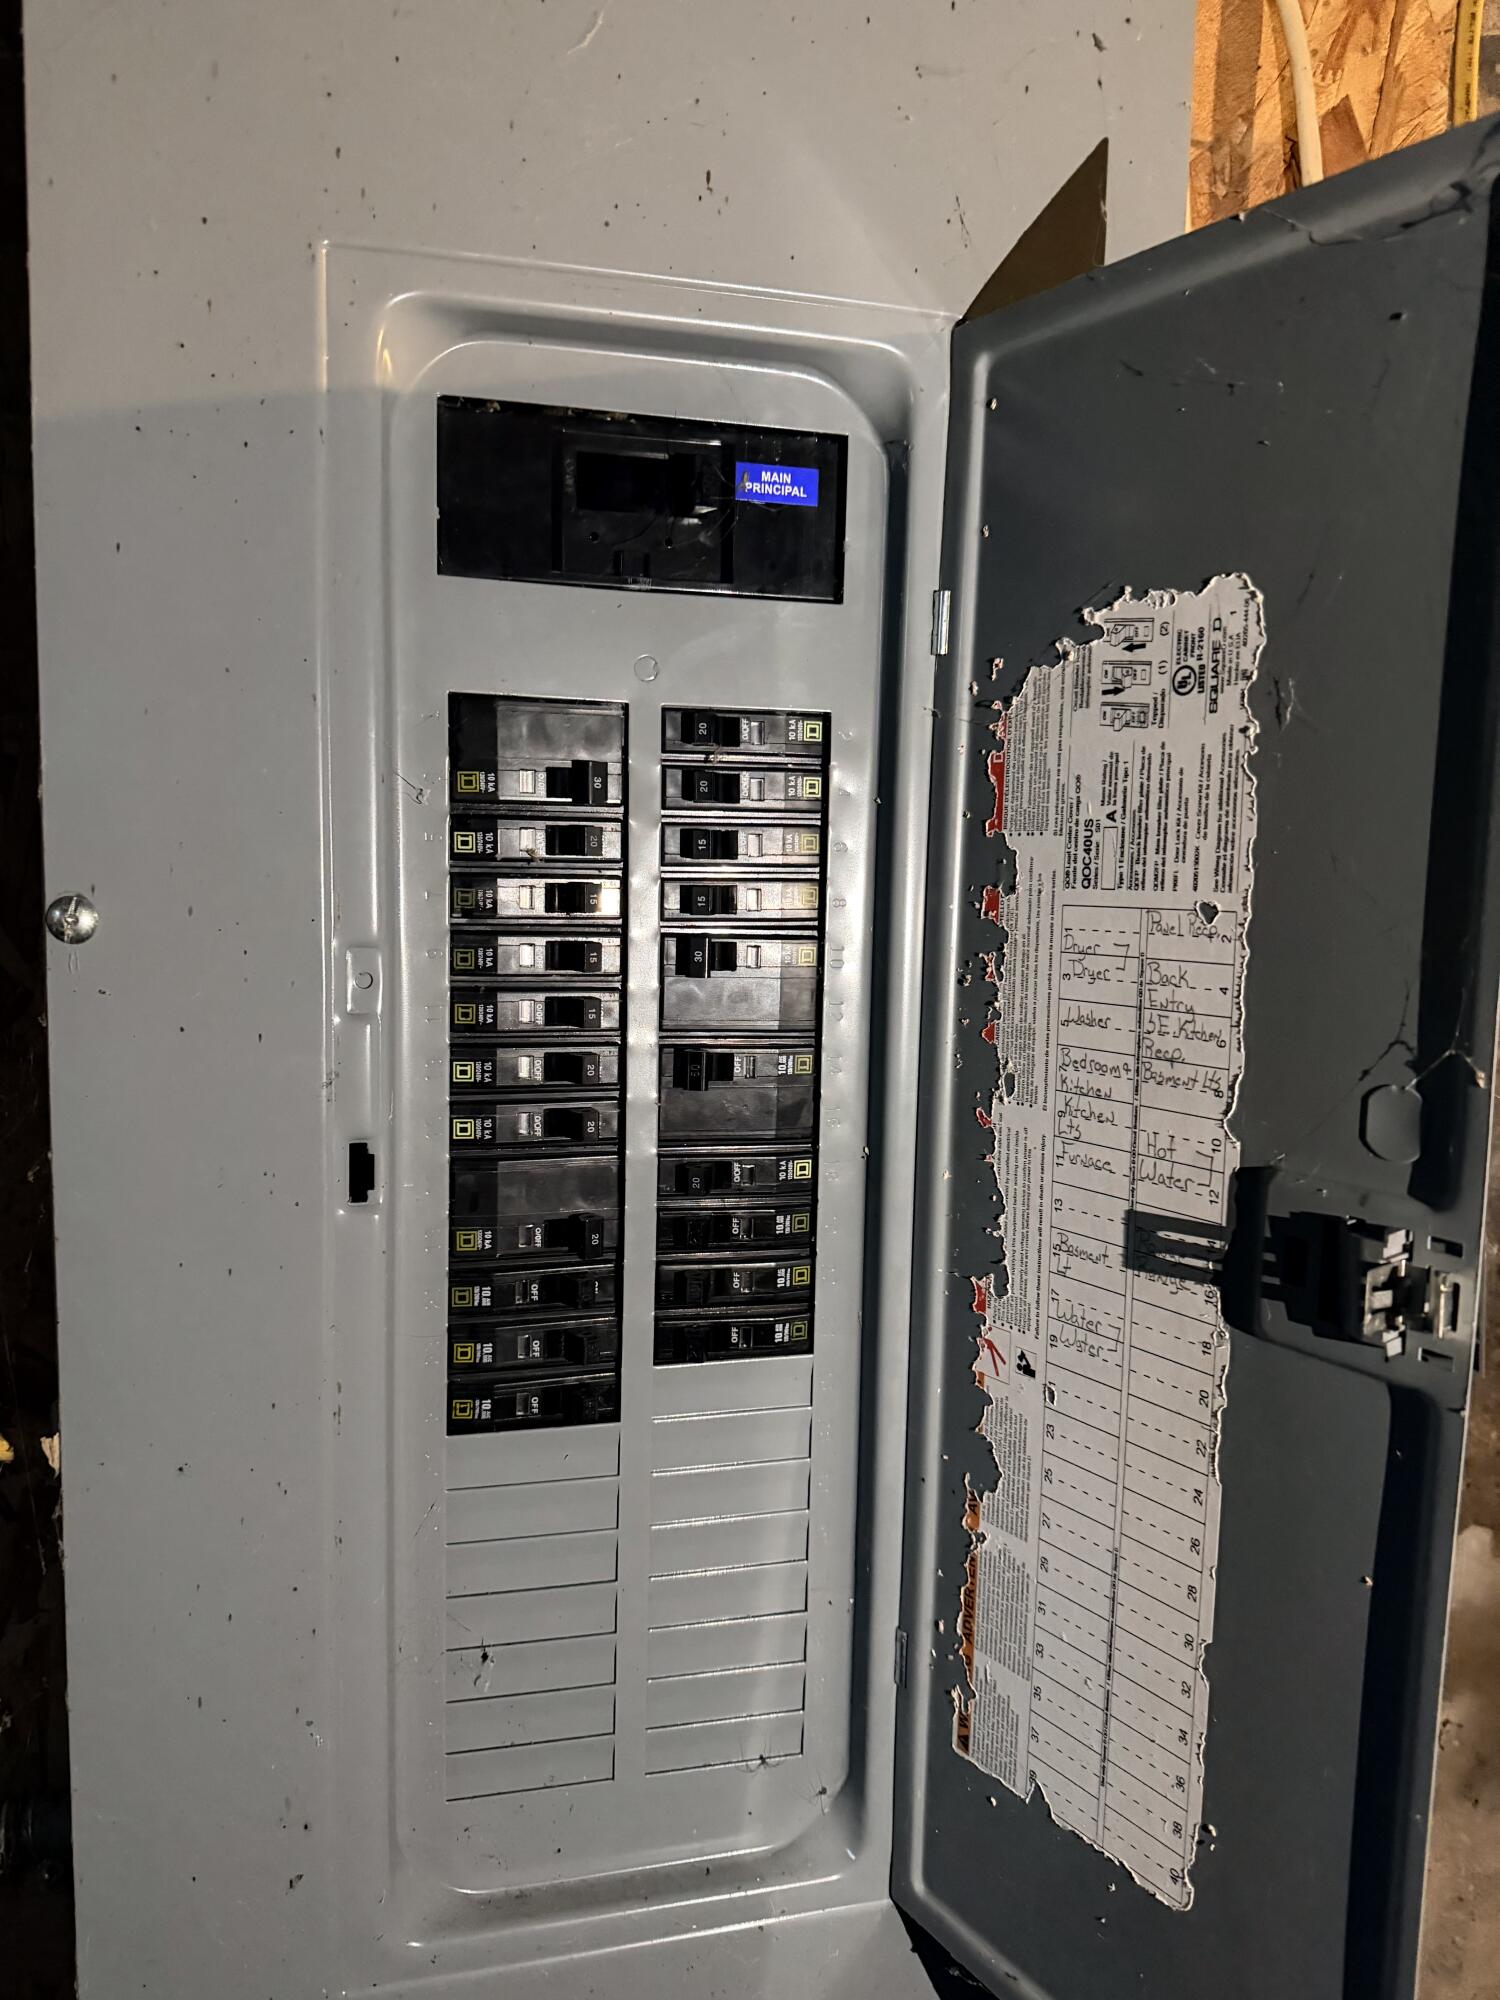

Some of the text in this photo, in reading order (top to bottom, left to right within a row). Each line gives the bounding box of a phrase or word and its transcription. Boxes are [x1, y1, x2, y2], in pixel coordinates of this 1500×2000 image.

[762, 471, 791, 484] MAIN
[745, 482, 807, 498] PRINCIPAL
[1160, 622, 1169, 636] (2)
[1196, 626, 1204, 661] R-2160
[1158, 660, 1168, 675] (1)
[1208, 617, 1222, 714] SQUARE D
[1197, 664, 1206, 694] LISTED
[1151, 696, 1159, 726] Tripped
[1158, 688, 1166, 728] Disparado
[698, 722, 707, 735] 20
[1122, 766, 1130, 782] Tipo
[594, 777, 602, 788] 30
[700, 780, 708, 792] 20
[1106, 810, 1117, 822] A
[590, 836, 598, 847] 20
[698, 839, 706, 850] 15
[1082, 818, 1094, 890] QOC40US
[590, 894, 598, 905] 15
[698, 896, 706, 908] 15
[1220, 934, 1232, 943] 2
[1064, 934, 1101, 962] Dryer
[590, 952, 598, 964] 15
[694, 951, 702, 962] 30
[1068, 960, 1110, 984] Dryer
[1147, 962, 1189, 988] Back
[1219, 987, 1228, 996] 4
[588, 1008, 596, 1019] 15
[1216, 1040, 1226, 1048] 6
[587, 1064, 595, 1076] 20
[734, 1056, 742, 1074] OFF
[1060, 1048, 1121, 1076] Bedroom
[1214, 1090, 1224, 1098] 8
[1058, 1110, 1066, 1118] 9
[587, 1121, 595, 1133] 20
[1147, 1132, 1176, 1160] Hot
[1211, 1138, 1222, 1154] 10
[1056, 1154, 1064, 1167] 11
[692, 1177, 700, 1189] 20
[1140, 1158, 1196, 1192] Water
[1208, 1189, 1219, 1204] 12
[1054, 1198, 1062, 1212] 13
[732, 1218, 740, 1234] OFF
[592, 1234, 600, 1246] 20
[1052, 1244, 1060, 1257] 15
[531, 1284, 539, 1301] OFF
[1051, 1288, 1060, 1302] 17
[1204, 1289, 1214, 1306] 16
[1056, 1300, 1102, 1333] Water
[532, 1340, 540, 1358] OFF
[1050, 1334, 1058, 1348] 19
[1060, 1324, 1104, 1358] Water
[1202, 1340, 1212, 1356] 18
[531, 1396, 539, 1414] OFF
[1199, 1390, 1209, 1408] 20
[1046, 1424, 1054, 1440] 23
[1196, 1439, 1207, 1458] 22
[1044, 1468, 1052, 1484] 25
[1193, 1488, 1202, 1506] 24
[1042, 1512, 1050, 1528] 27
[1190, 1537, 1200, 1556] 26
[1040, 1556, 1049, 1573] 29
[1188, 1584, 1197, 1602] 28
[1038, 1600, 1046, 1616] 31
[1036, 1642, 1044, 1658] 33
[1184, 1633, 1194, 1652] 30
[1033, 1686, 1042, 1701] 35
[1181, 1680, 1191, 1698] 32
[1030, 1726, 1039, 1743] 37
[1178, 1728, 1188, 1746] 34
[1176, 1776, 1185, 1793] 36
[1172, 1821, 1182, 1839] 38
[1170, 1868, 1179, 1886] 40
